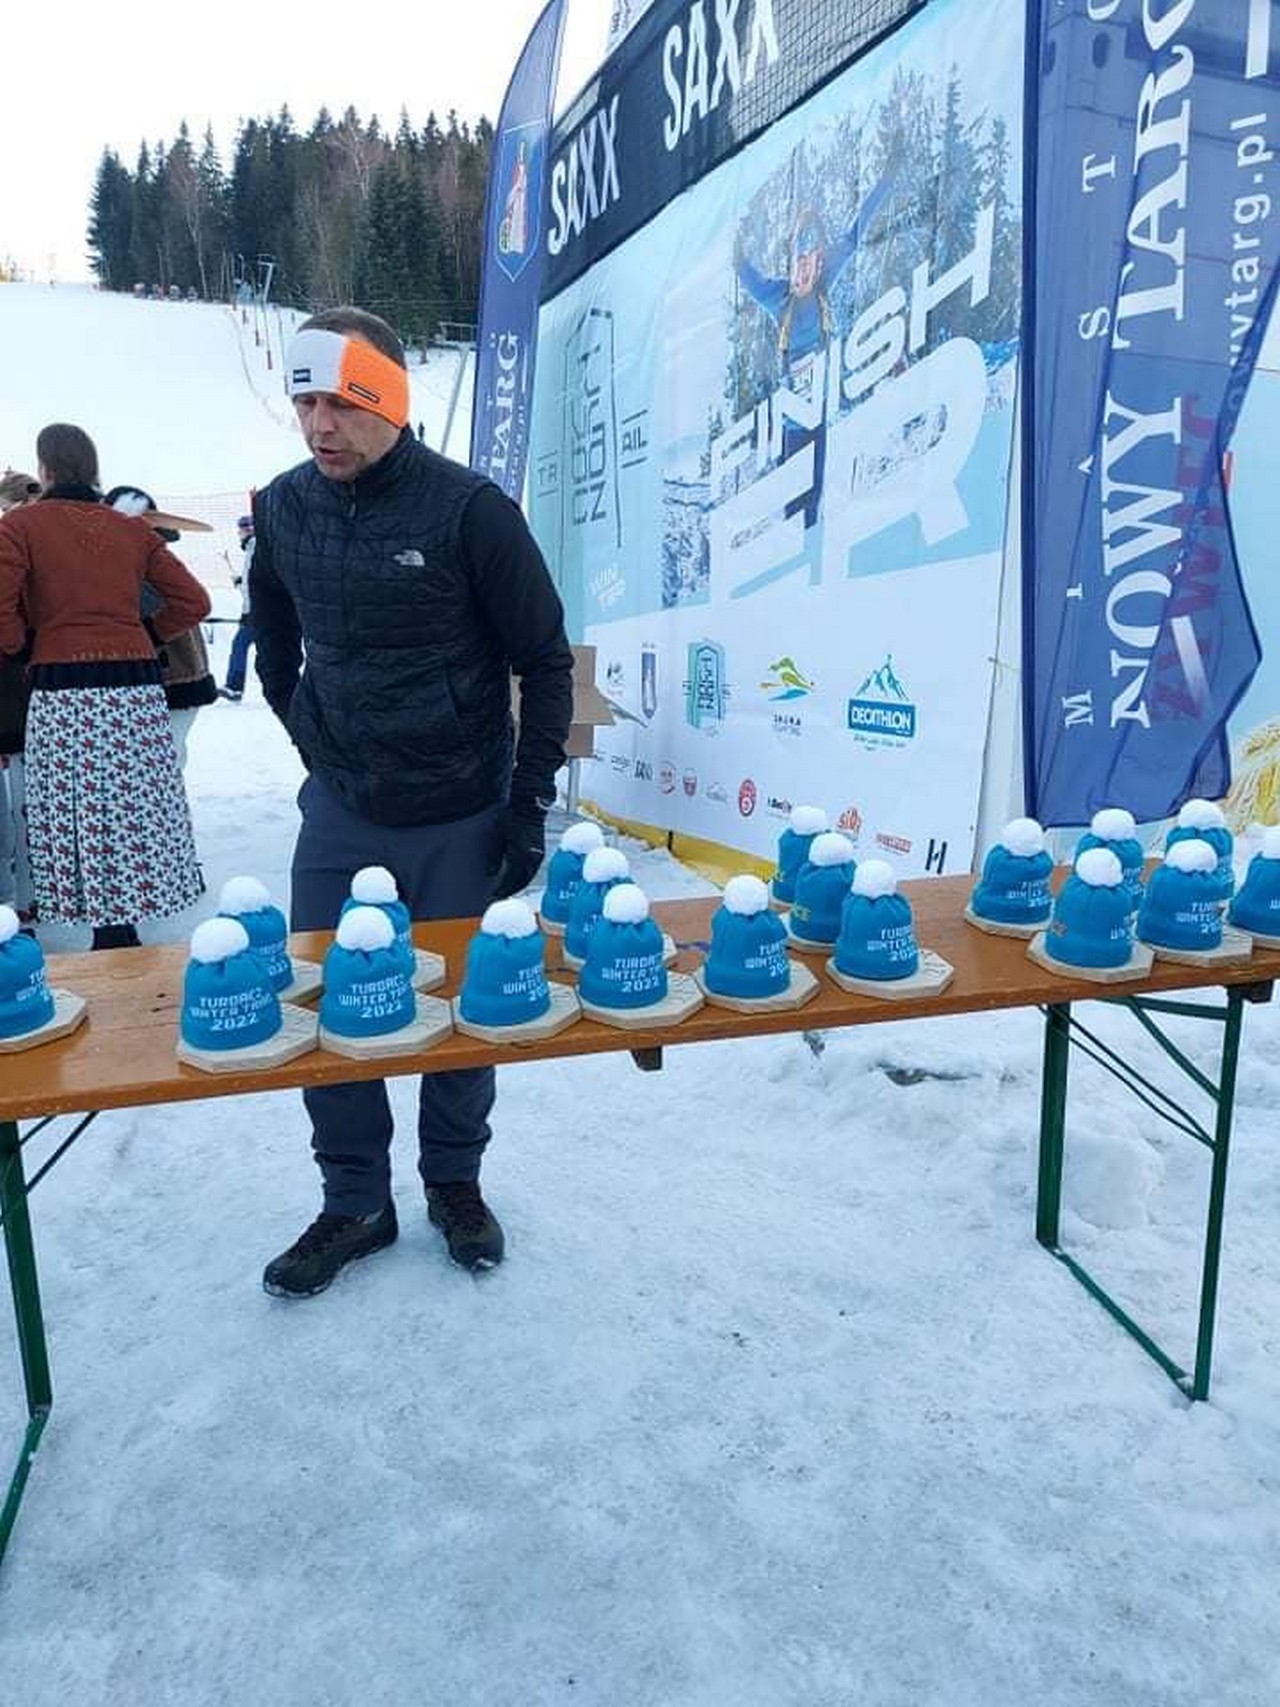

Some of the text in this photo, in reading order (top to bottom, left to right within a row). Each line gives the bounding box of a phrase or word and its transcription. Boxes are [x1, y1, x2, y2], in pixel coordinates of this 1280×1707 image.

[662, 0, 780, 151] SAXX
[547, 94, 621, 256] SAXX
[711, 198, 996, 511] FINISH
[1102, 391, 1184, 728] NOWY
[851, 705, 912, 732] DECATHLON
[210, 1011, 259, 1031] 2022
[338, 993, 387, 1007] WINTER
[360, 1000, 402, 1018] 2022
